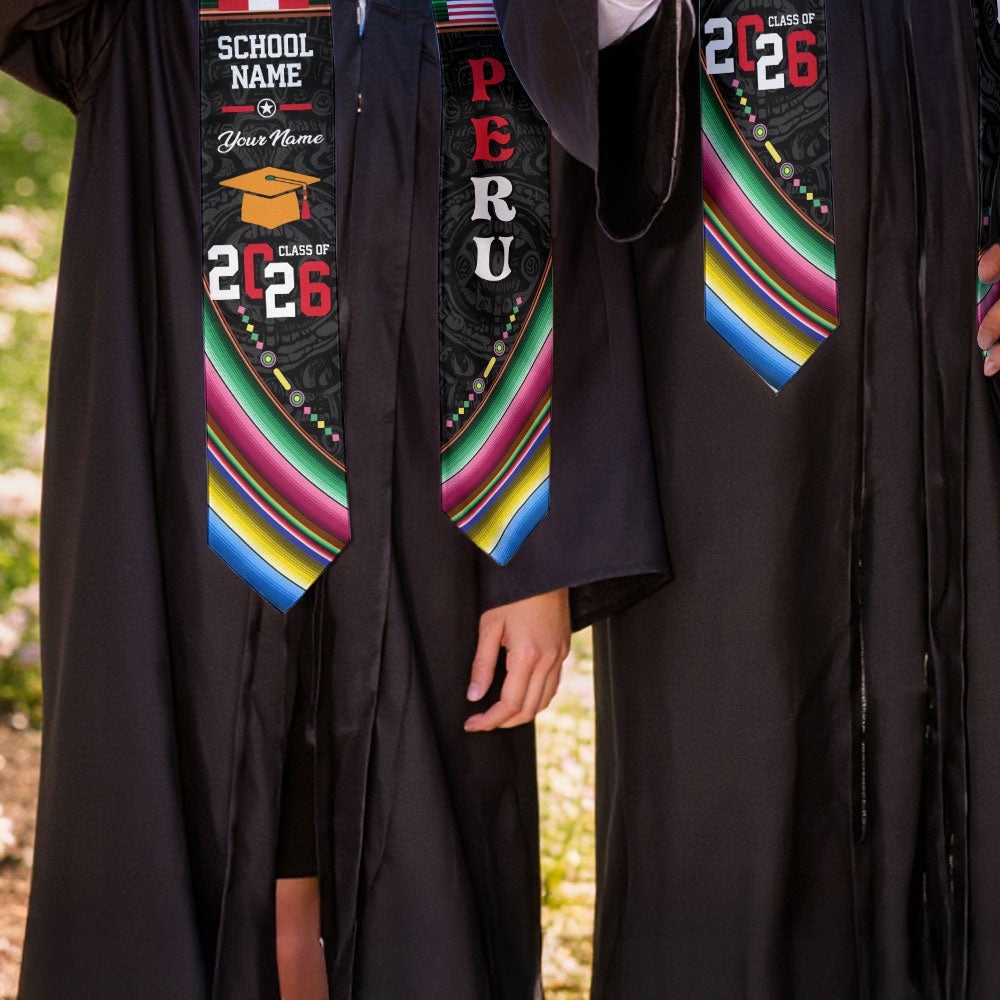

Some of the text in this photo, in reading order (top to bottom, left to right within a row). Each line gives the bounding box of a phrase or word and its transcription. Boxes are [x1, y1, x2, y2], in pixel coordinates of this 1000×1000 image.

[768, 12, 816, 27] CLASS OF
[217, 33, 313, 60] SCHOOL
[704, 14, 818, 90] 2026
[230, 63, 302, 90] NAME
[217, 128, 324, 154] Your Name
[467, 57, 517, 282] PERU
[278, 243, 330, 257] CLASS OF
[207, 243, 332, 319] 2026
